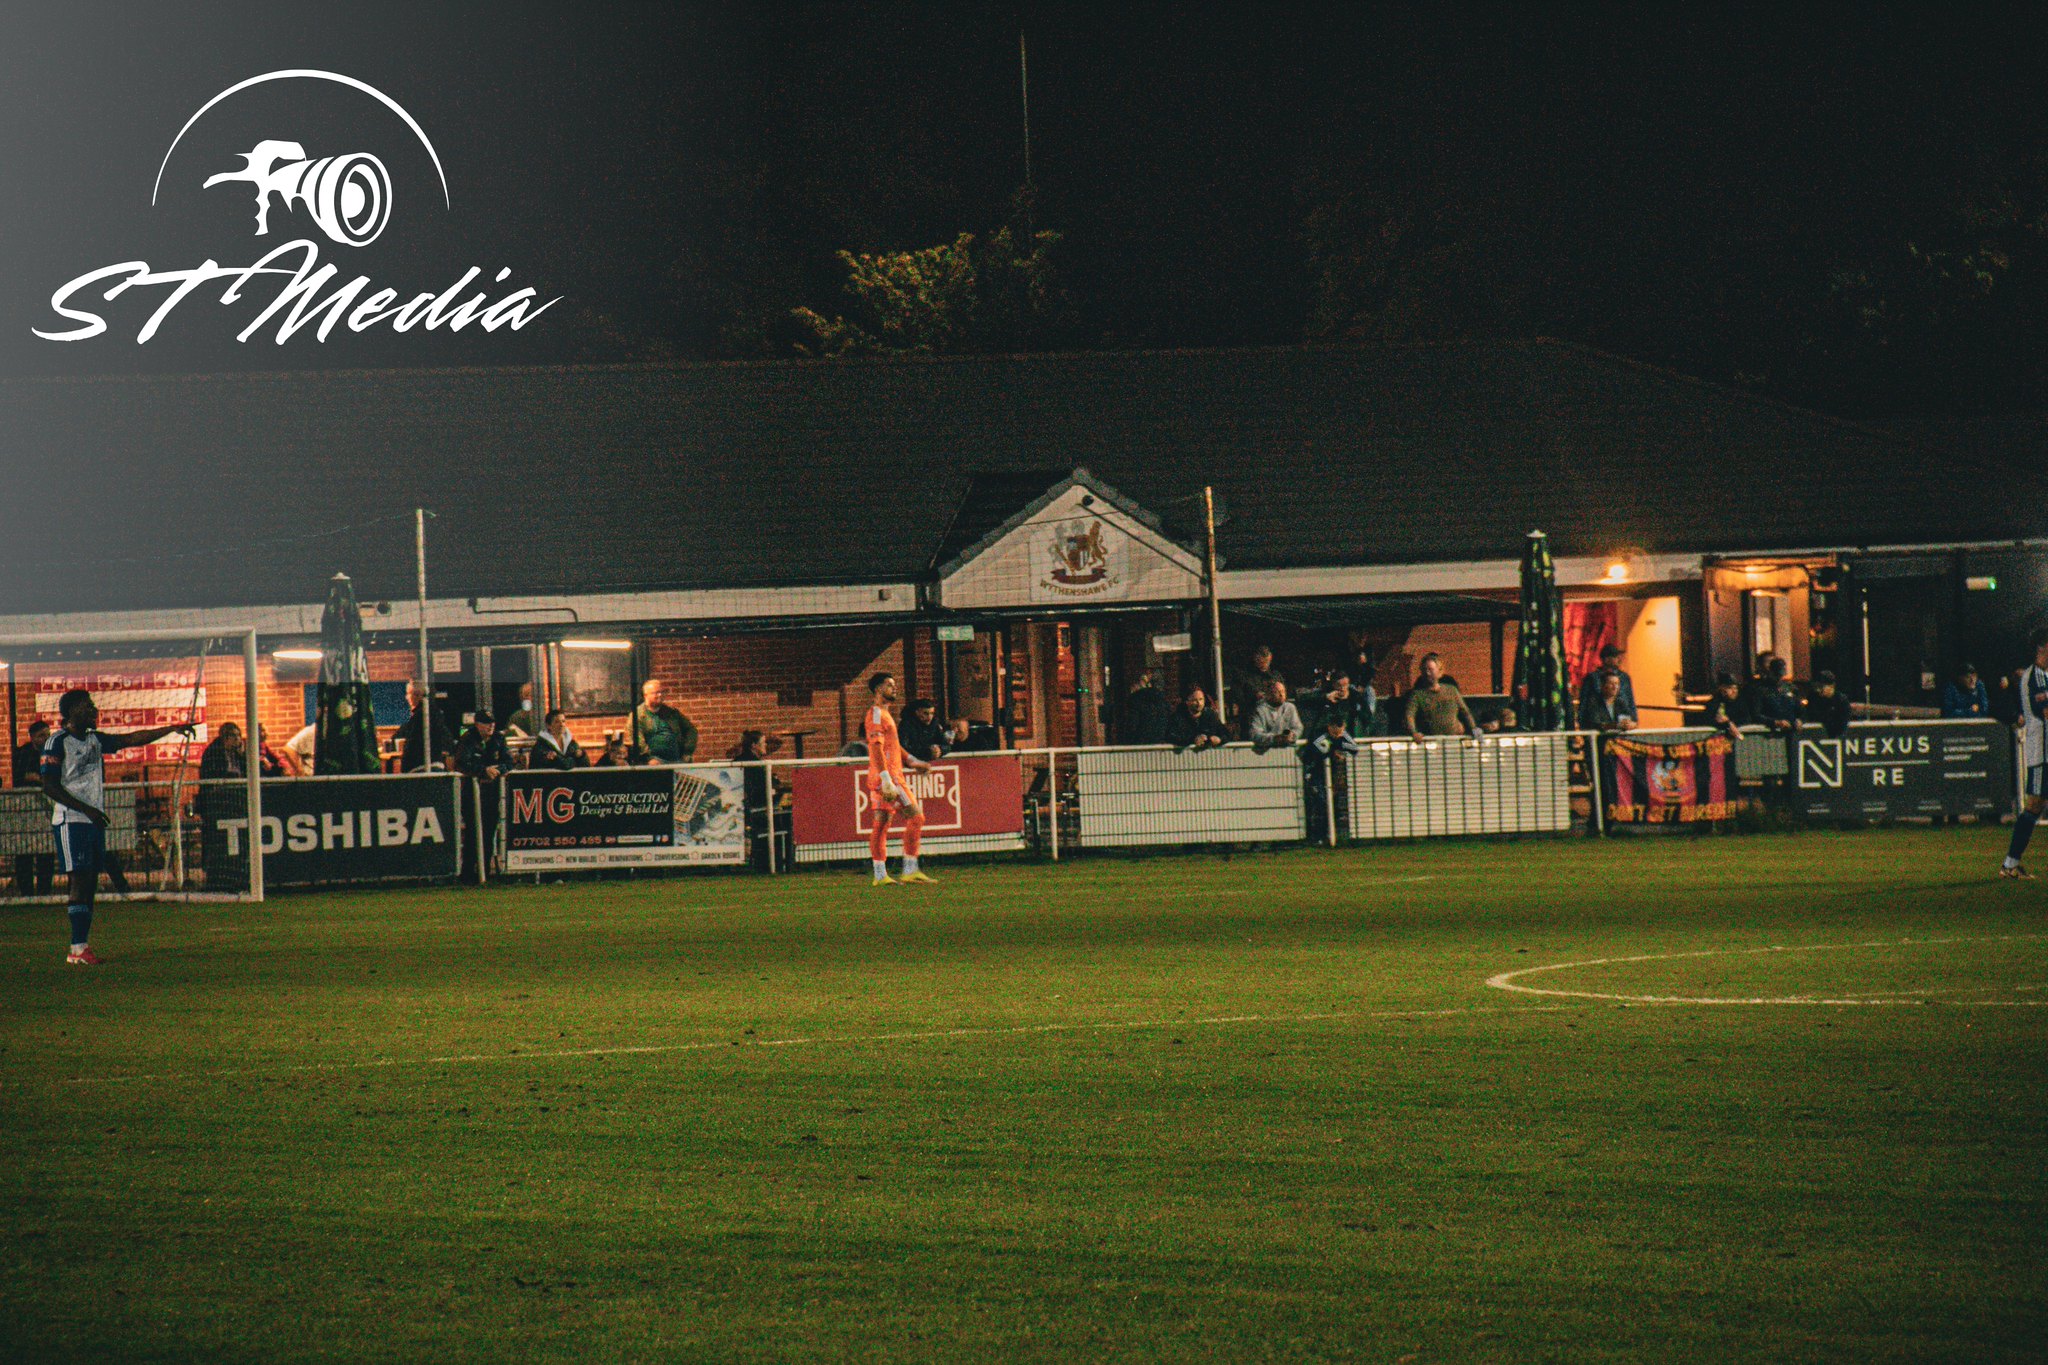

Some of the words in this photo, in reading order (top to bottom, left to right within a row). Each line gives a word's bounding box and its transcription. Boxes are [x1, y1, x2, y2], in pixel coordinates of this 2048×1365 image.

[1040, 579, 1107, 596] WYTHENSHAWE
[1108, 576, 1120, 588] FC
[1845, 736, 1930, 755] NEXUS
[905, 773, 945, 798] HING
[1872, 768, 1904, 786] RE
[512, 787, 575, 824] MG
[580, 804, 612, 818] Design
[614, 803, 624, 815] &
[626, 802, 650, 815] Build
[652, 801, 669, 814] Ltd
[217, 806, 445, 856] TOSHIBA
